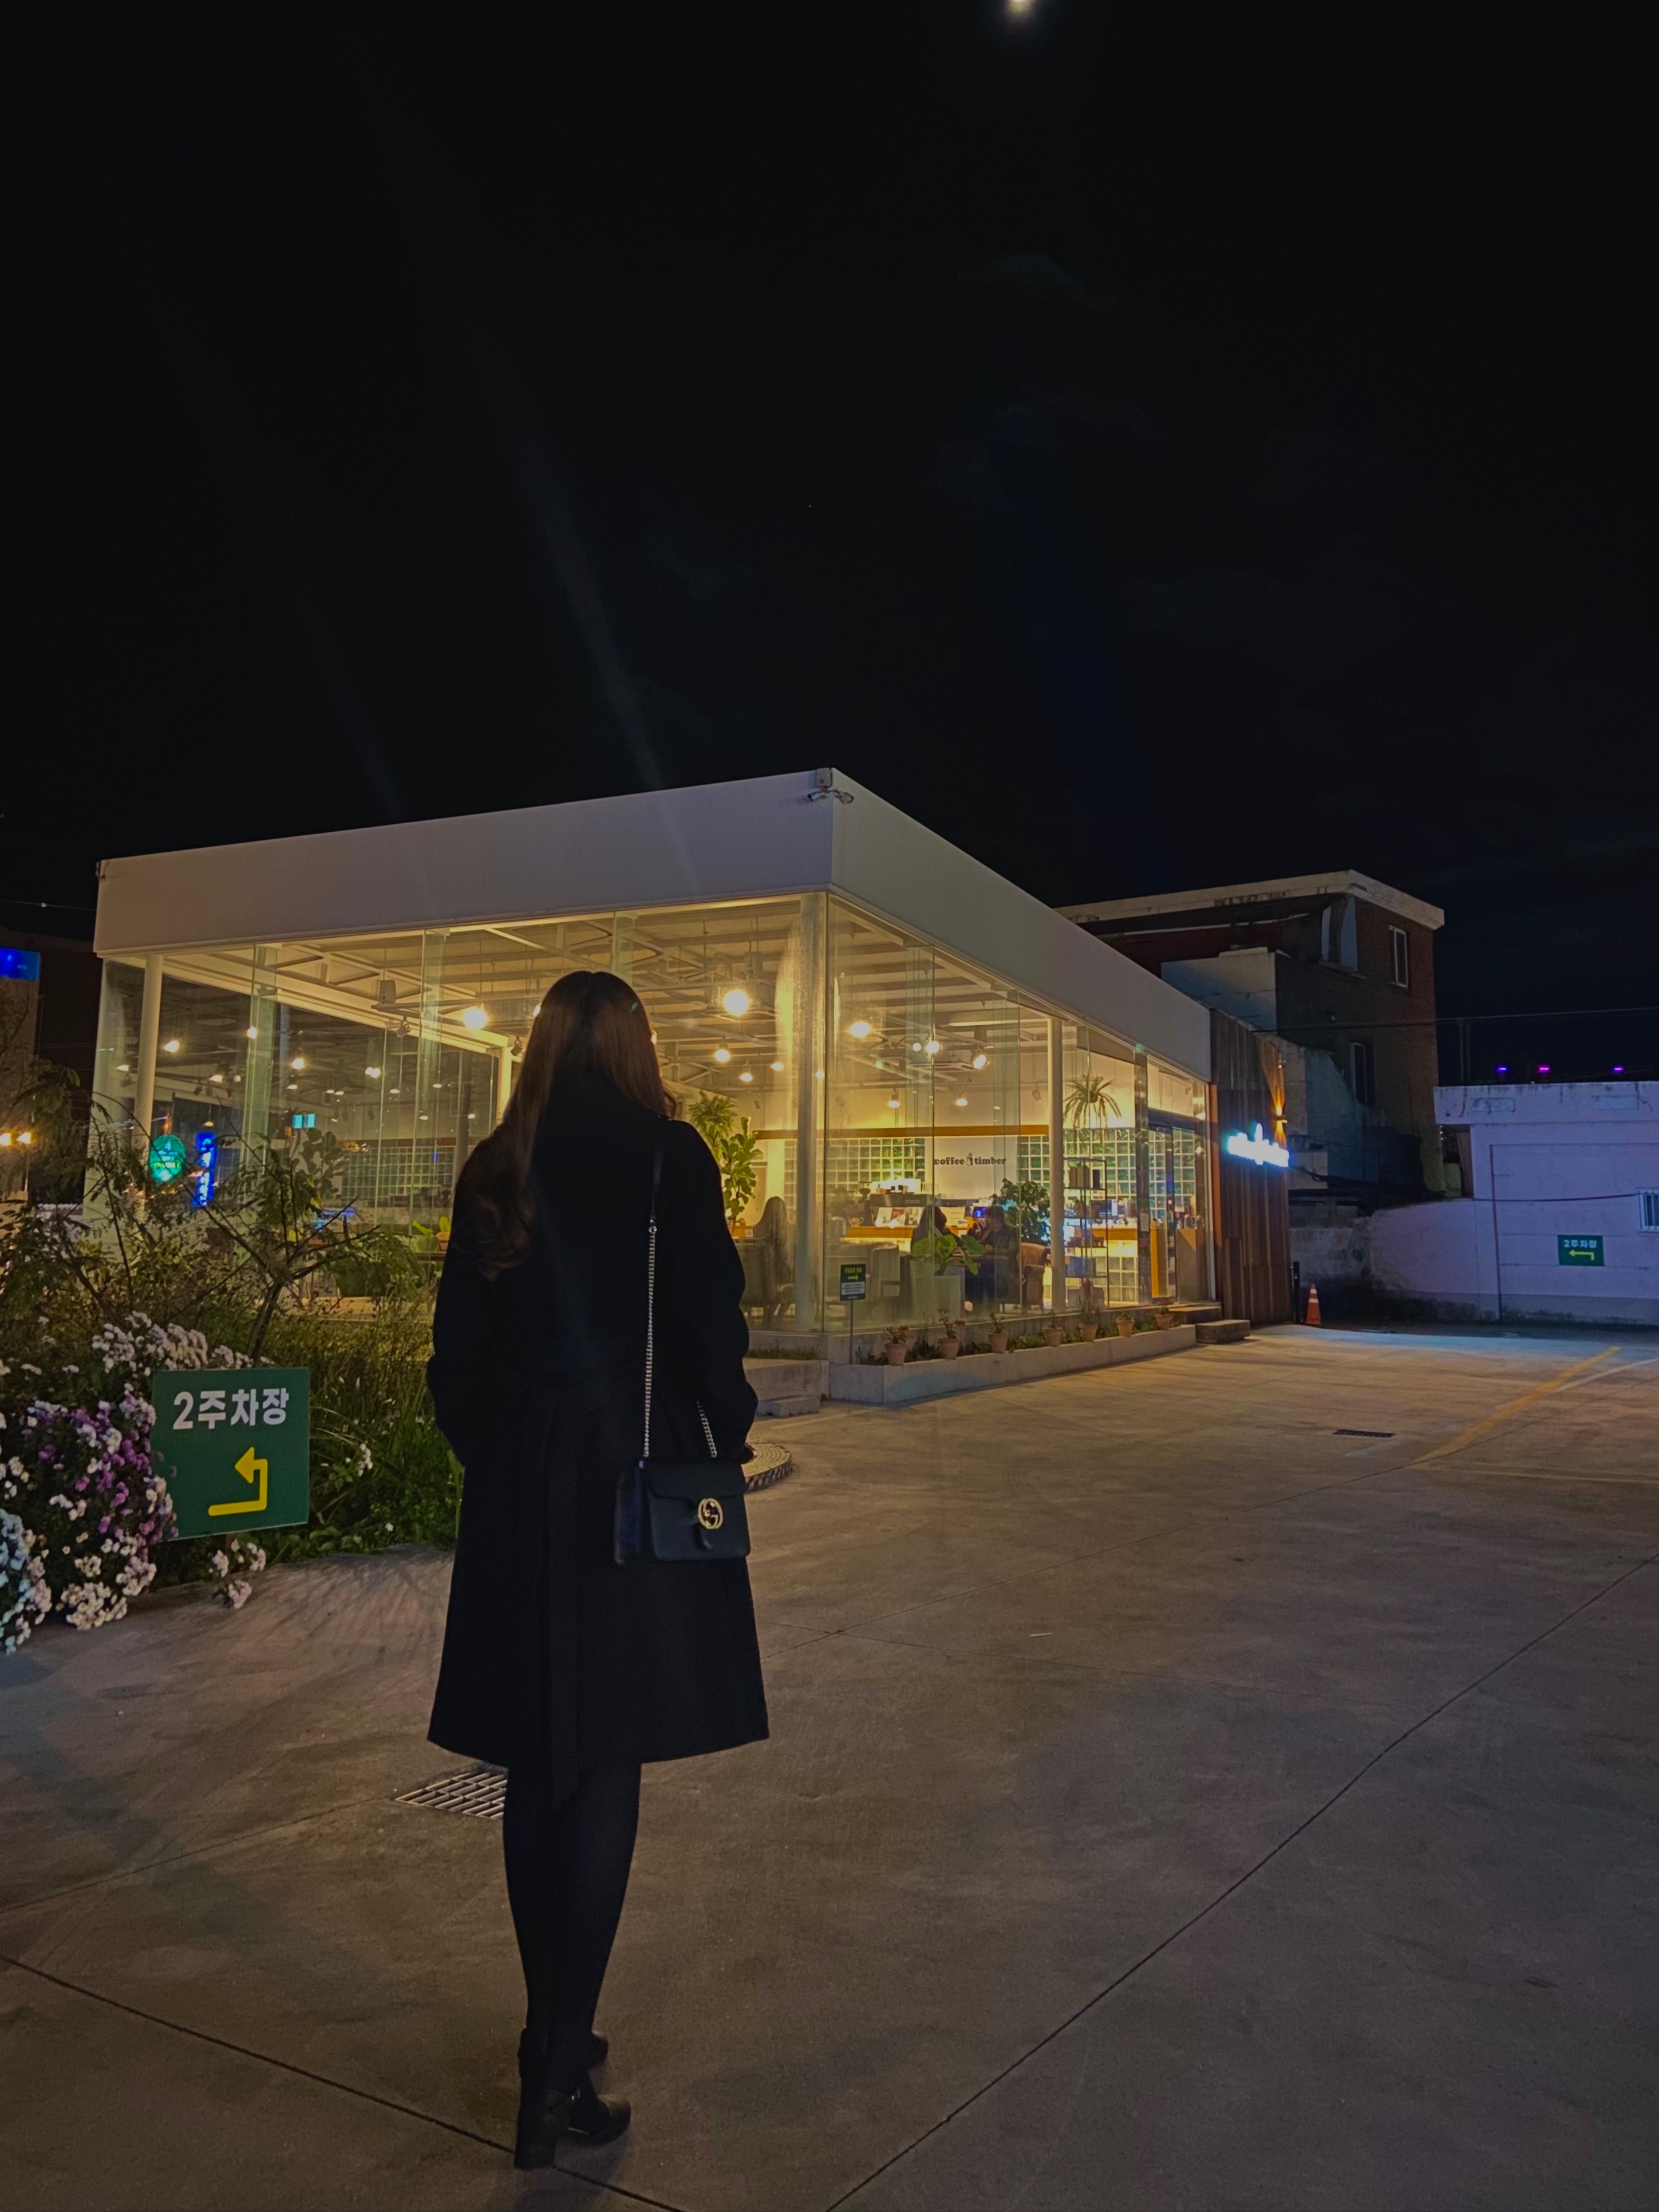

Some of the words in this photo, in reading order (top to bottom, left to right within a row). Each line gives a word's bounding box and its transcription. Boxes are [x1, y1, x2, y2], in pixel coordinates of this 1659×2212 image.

[934, 1157, 965, 1165] coffee
[974, 1157, 1006, 1165] timber
[173, 1388, 289, 1429] 2주차장
